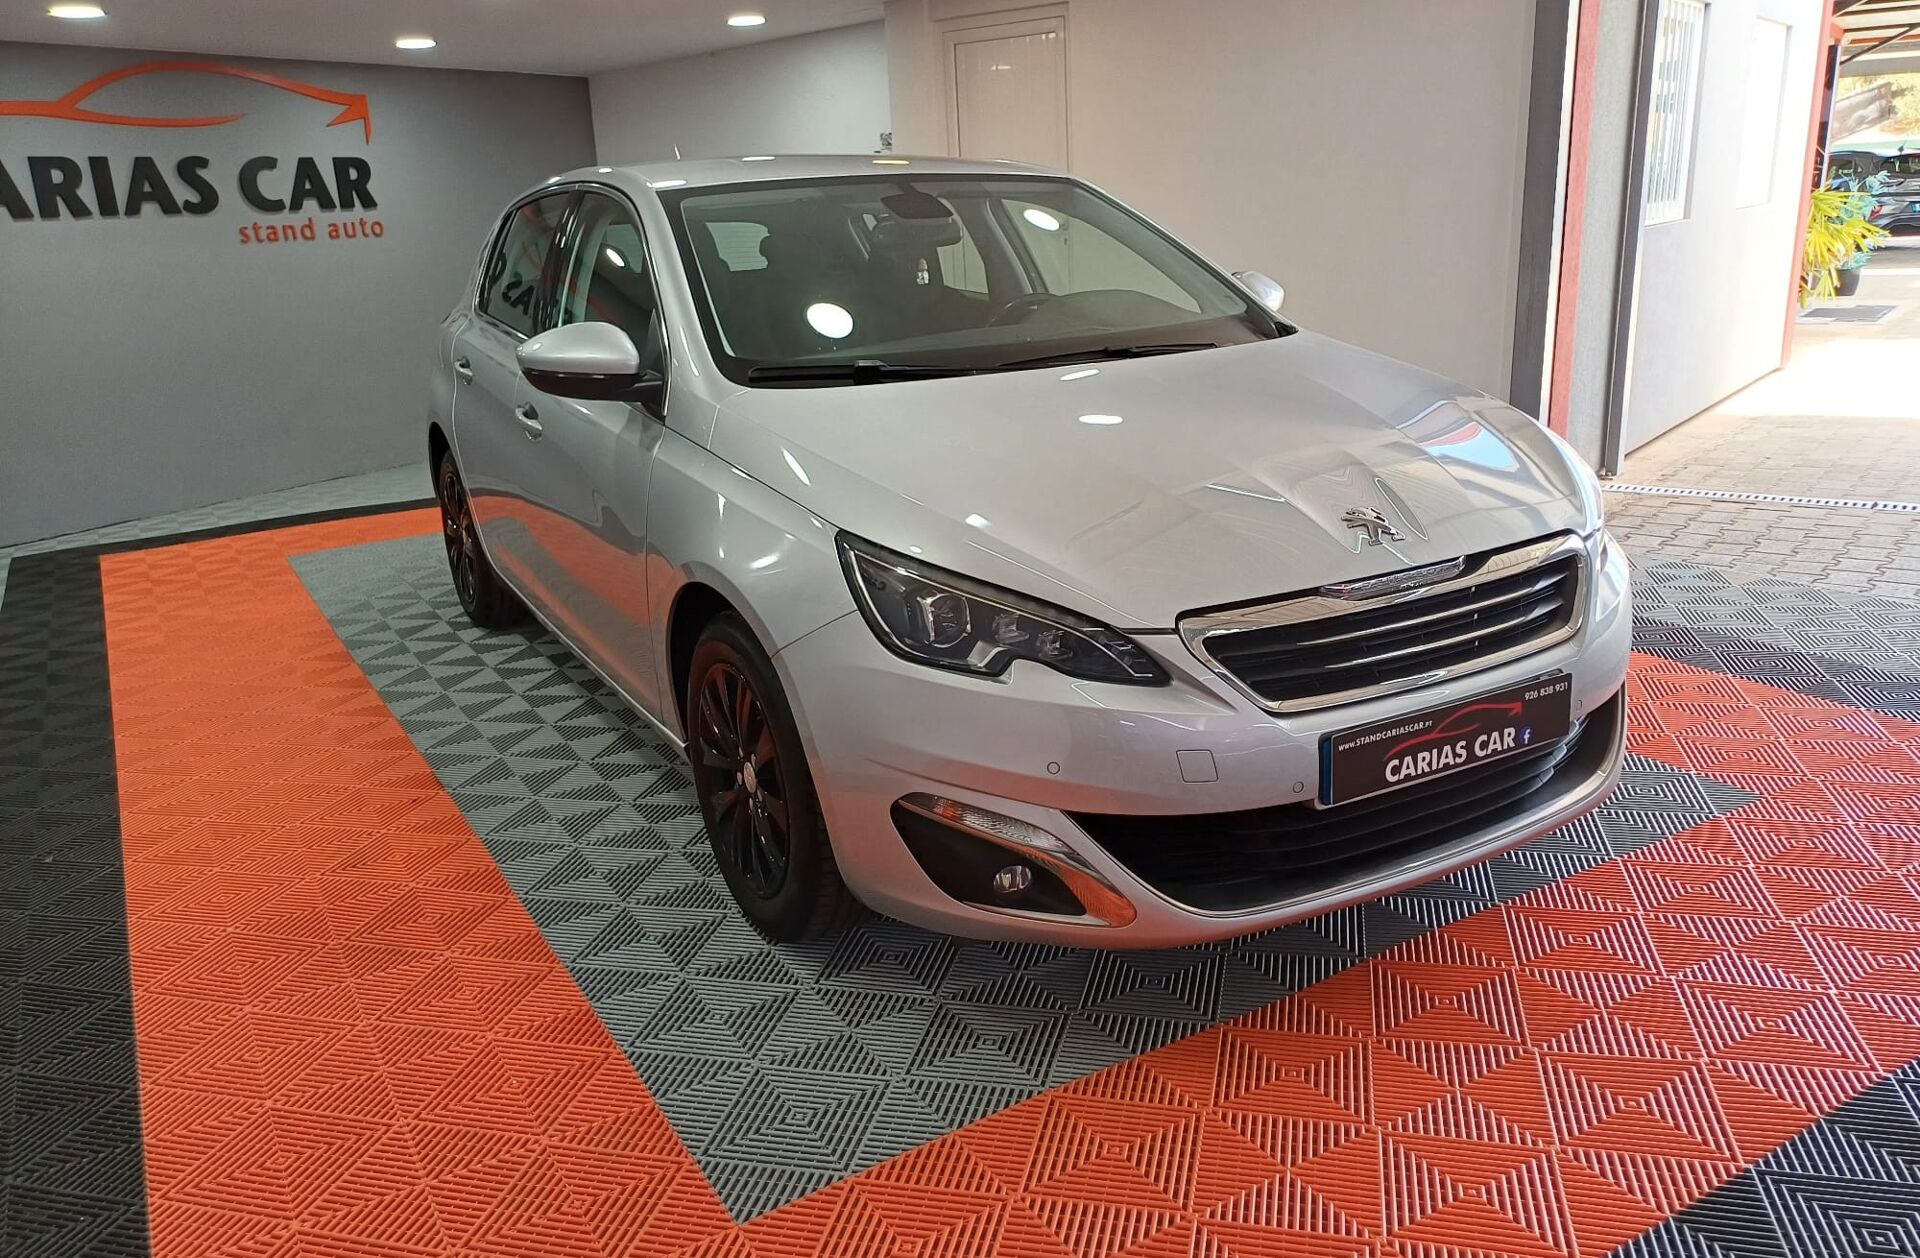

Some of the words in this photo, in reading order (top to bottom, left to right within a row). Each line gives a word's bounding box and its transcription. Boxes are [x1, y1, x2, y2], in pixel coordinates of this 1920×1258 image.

[239, 156, 378, 212] CAR
[238, 217, 316, 243] stand
[328, 217, 384, 240] auto
[1525, 689, 1539, 701] 926
[1555, 681, 1568, 693] 931
[1385, 741, 1467, 783] CARIAS
[1474, 727, 1516, 758] CAR
